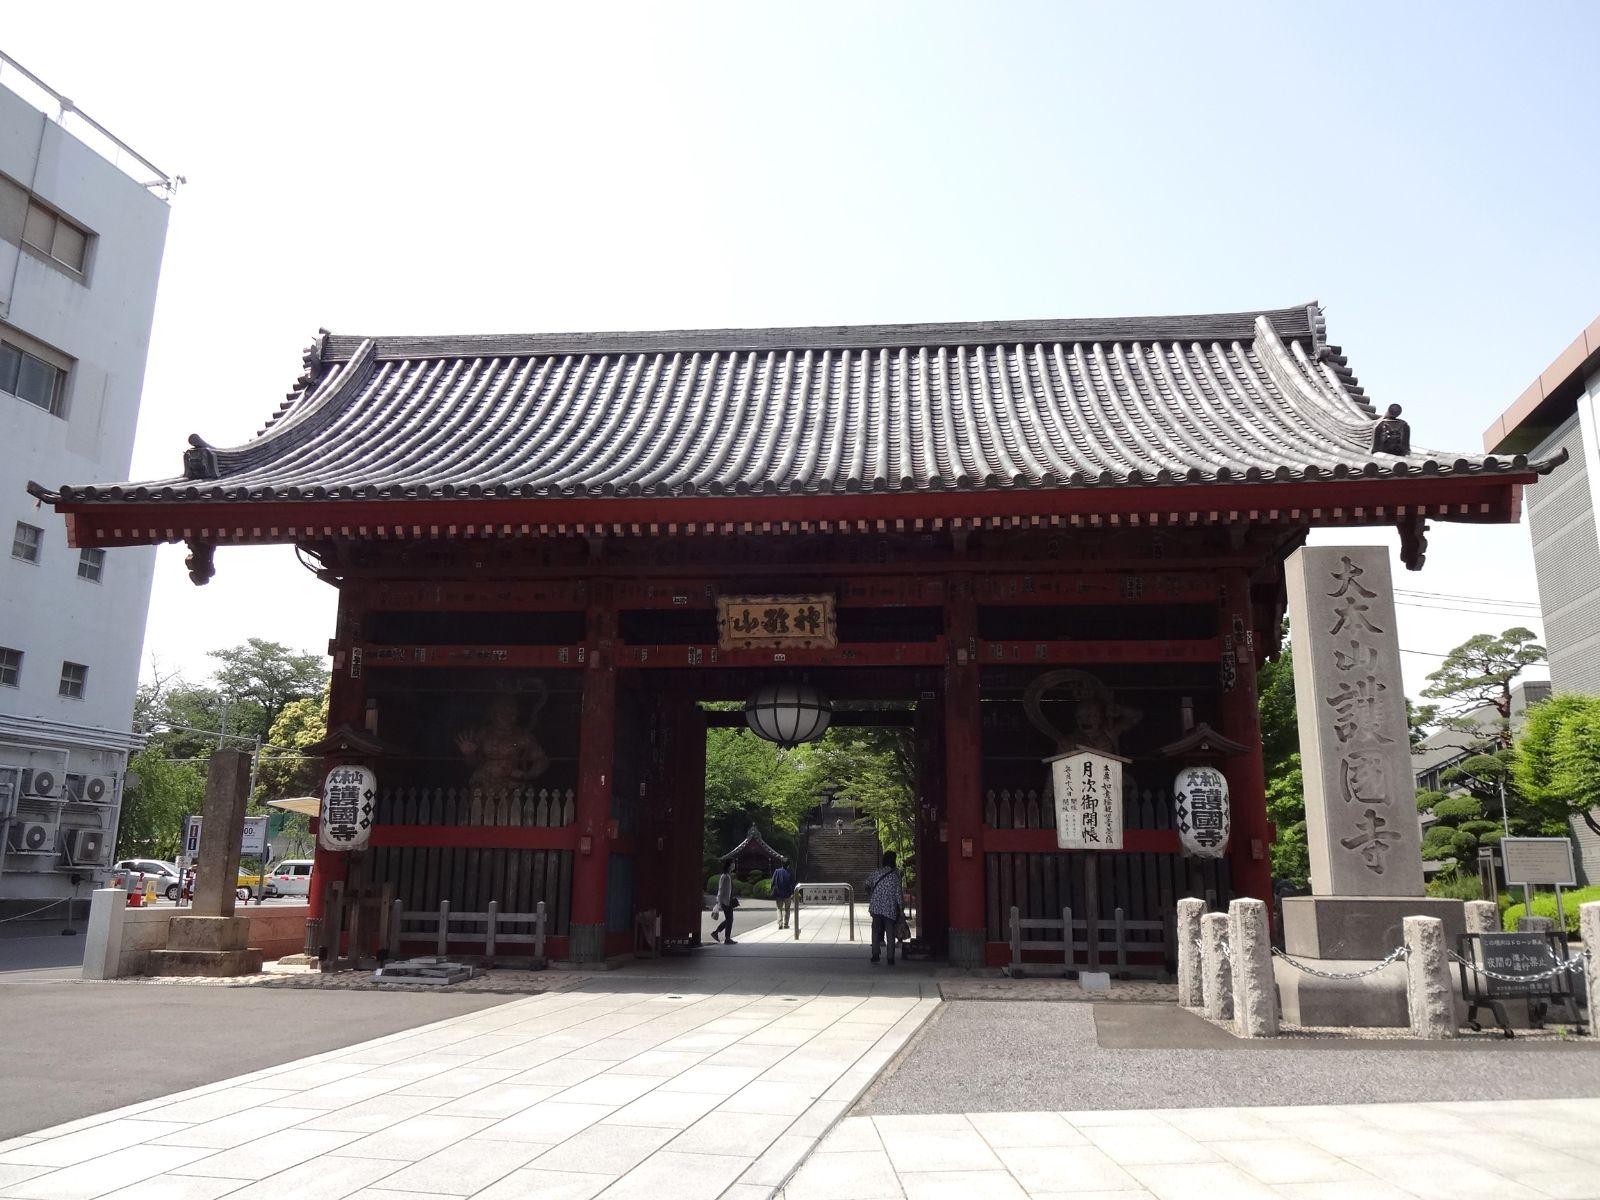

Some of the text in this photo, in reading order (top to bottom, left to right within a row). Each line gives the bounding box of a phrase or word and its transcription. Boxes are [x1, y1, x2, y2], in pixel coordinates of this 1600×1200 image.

[328, 770, 364, 785] 大本山
[1080, 760, 1101, 843] 月次御開帳
[1186, 771, 1222, 787] 大本山
[329, 785, 361, 841] 護國寺
[1190, 788, 1224, 847] 護國寺
